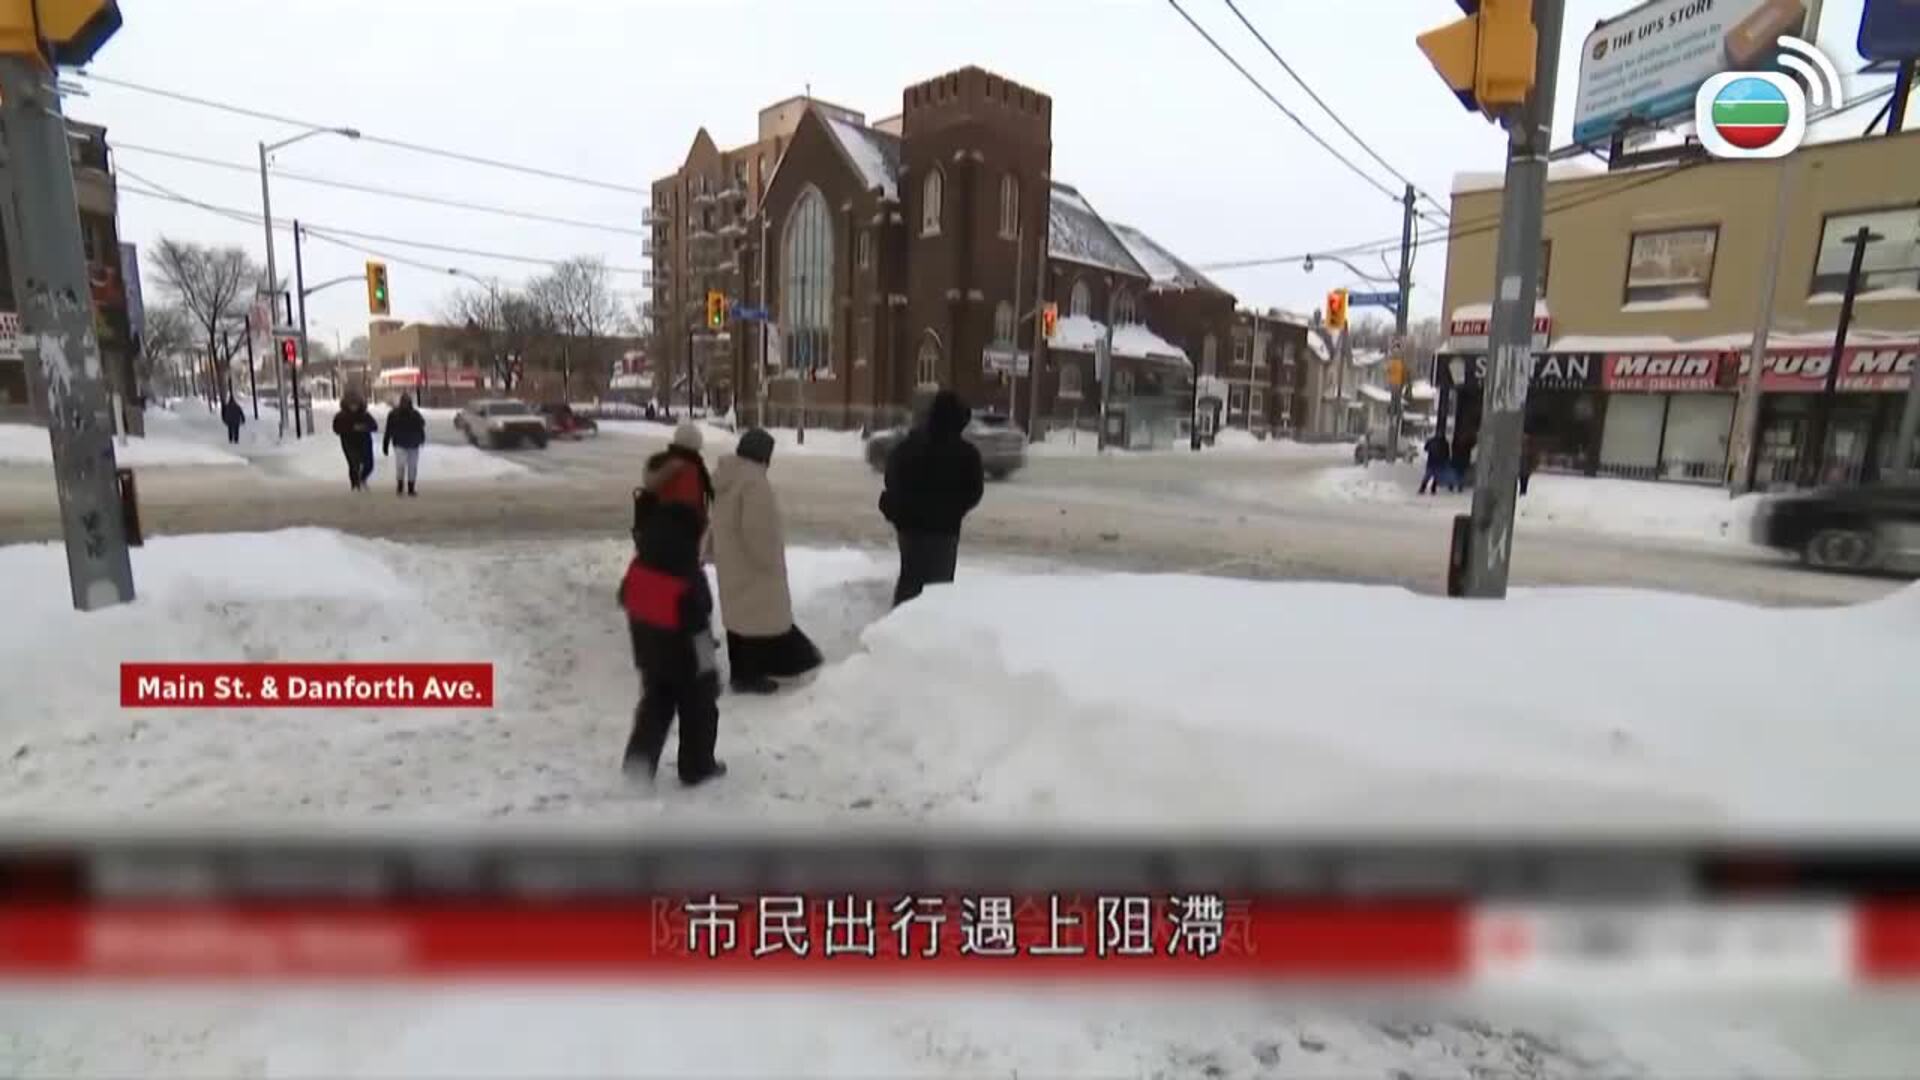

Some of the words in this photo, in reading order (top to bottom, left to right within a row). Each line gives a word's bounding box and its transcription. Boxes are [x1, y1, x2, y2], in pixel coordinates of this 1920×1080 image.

[1612, 31, 1633, 51] THE
[1638, 16, 1664, 40] UPS
[1669, 0, 1715, 26] STORE
[1475, 355, 1590, 379] STAN
[1613, 353, 1711, 375] Main
